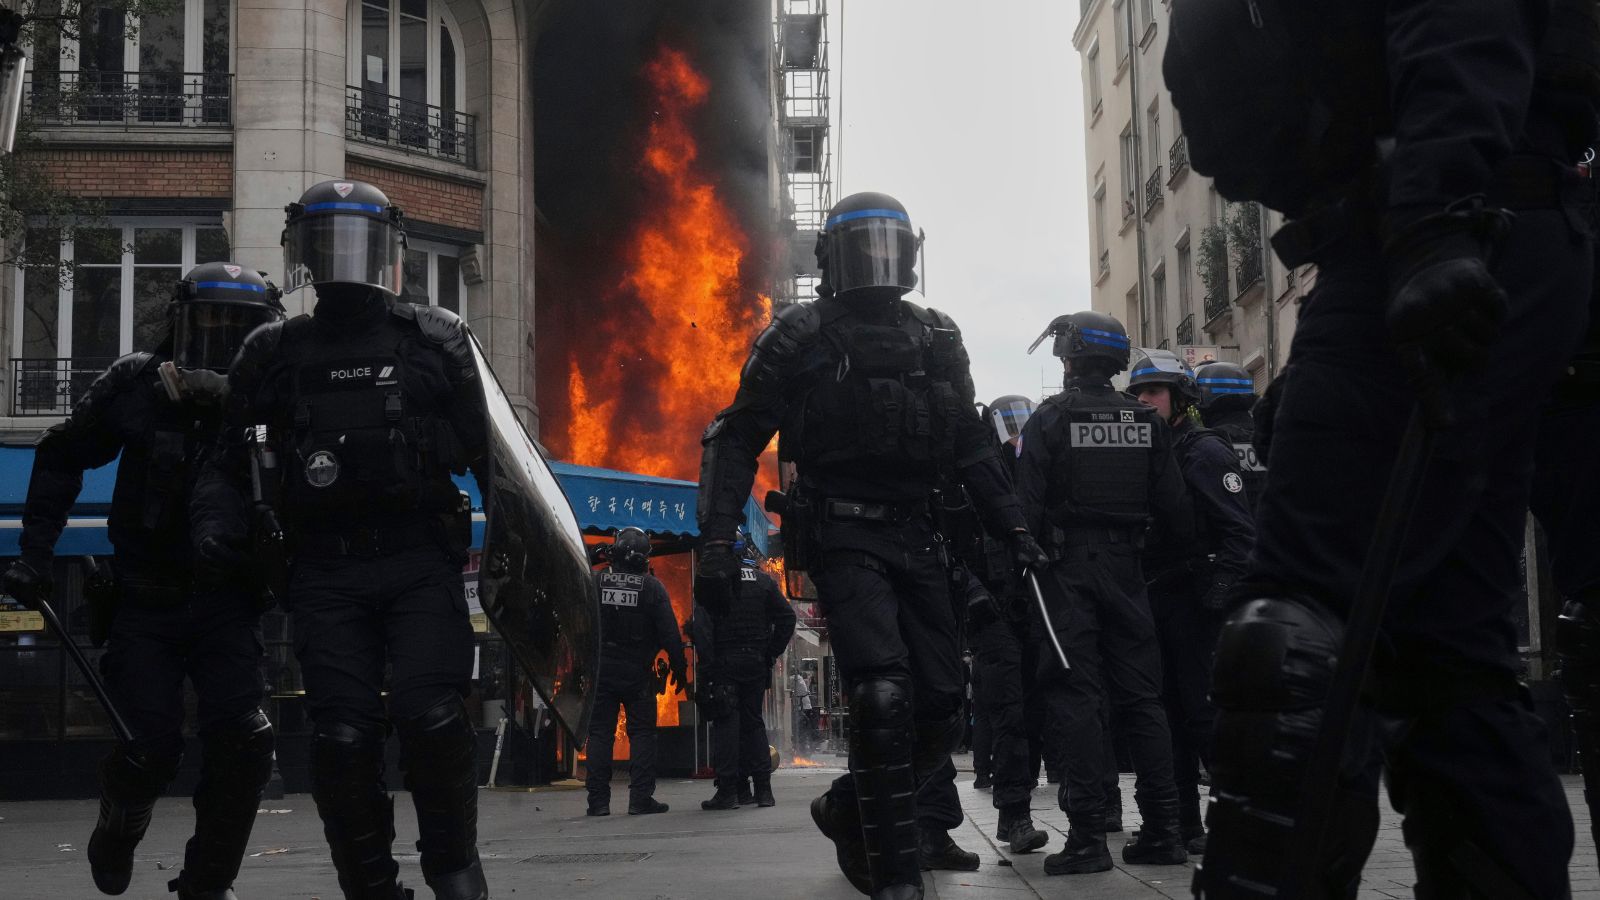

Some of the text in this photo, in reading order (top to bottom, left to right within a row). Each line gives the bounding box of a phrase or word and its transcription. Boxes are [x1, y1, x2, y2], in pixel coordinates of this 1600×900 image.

[331, 367, 371, 380] POLICE
[1079, 425, 1148, 444] POLICE
[603, 573, 642, 585] POLICE
[603, 591, 638, 604] TX 311
